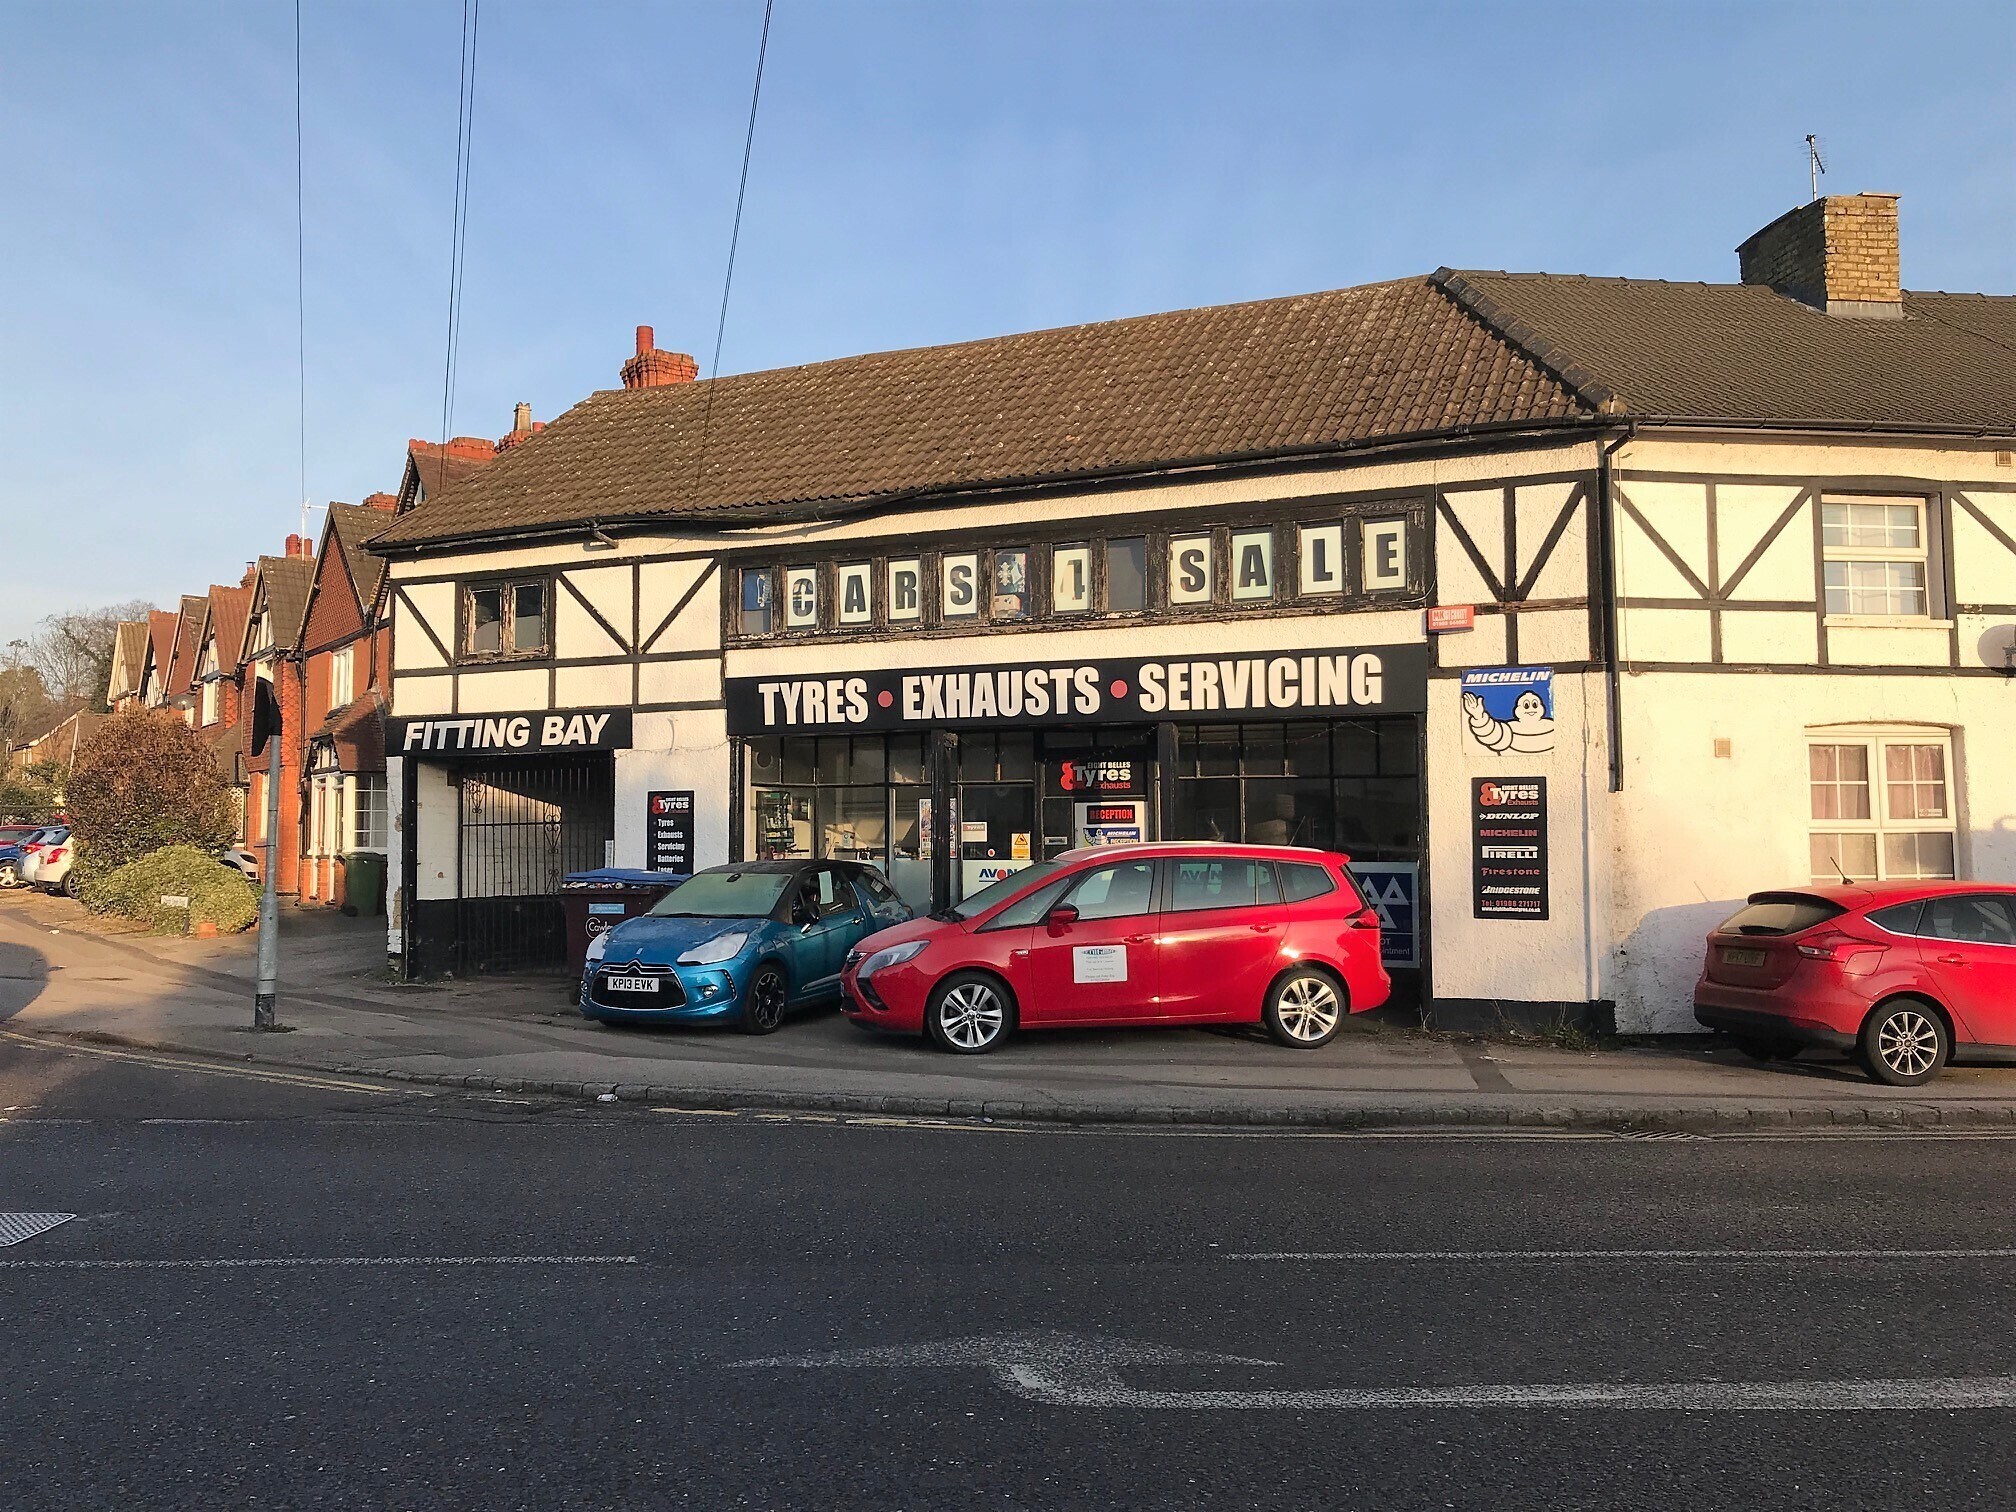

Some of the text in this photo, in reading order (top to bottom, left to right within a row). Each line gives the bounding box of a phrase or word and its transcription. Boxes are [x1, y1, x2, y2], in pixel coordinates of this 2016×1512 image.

[793, 532, 1399, 618] CARS 4 SALE
[1466, 671, 1550, 683] MICHELIN
[758, 653, 1382, 726] TYRES EXHAUSTS SERVICING
[403, 713, 611, 750] FITTING BAY
[1073, 766, 1131, 787] Tyres
[1490, 787, 1539, 804] Tyres
[658, 799, 689, 812] Tyres
[1090, 808, 1133, 819] RECEPTION
[658, 819, 674, 827] Tyres
[658, 831, 683, 839] Exhausts
[1480, 829, 1538, 837] MICHELIN
[658, 842, 685, 851] Servicing
[1482, 845, 1539, 859] PIRELLI
[658, 854, 684, 863] Batteries
[1481, 867, 1541, 876] Firestone
[1481, 885, 1541, 894] BRIDGESTONE
[612, 978, 653, 990] KP13 EVK
